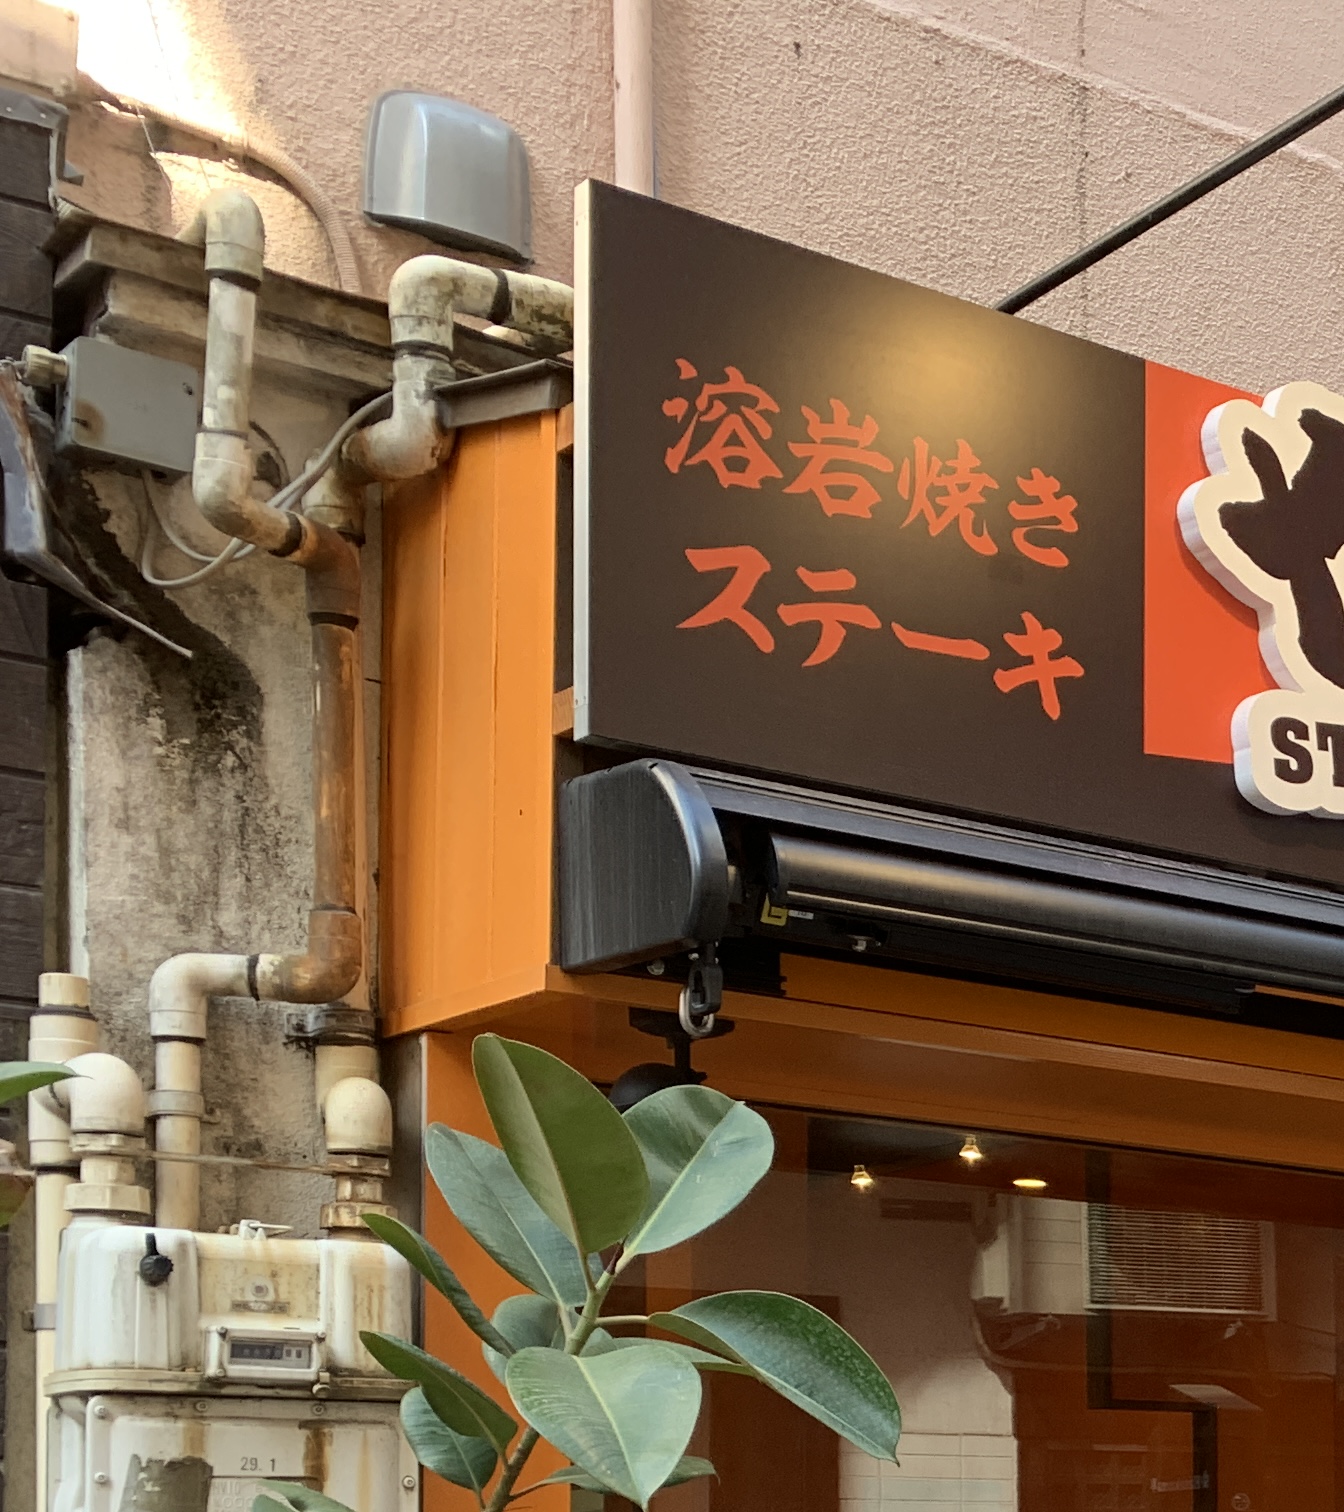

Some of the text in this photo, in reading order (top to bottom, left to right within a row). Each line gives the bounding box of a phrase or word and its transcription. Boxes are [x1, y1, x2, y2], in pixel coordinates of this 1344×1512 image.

[662, 358, 1079, 568] 溶岩焼き
[676, 545, 1085, 721] ステーキ
